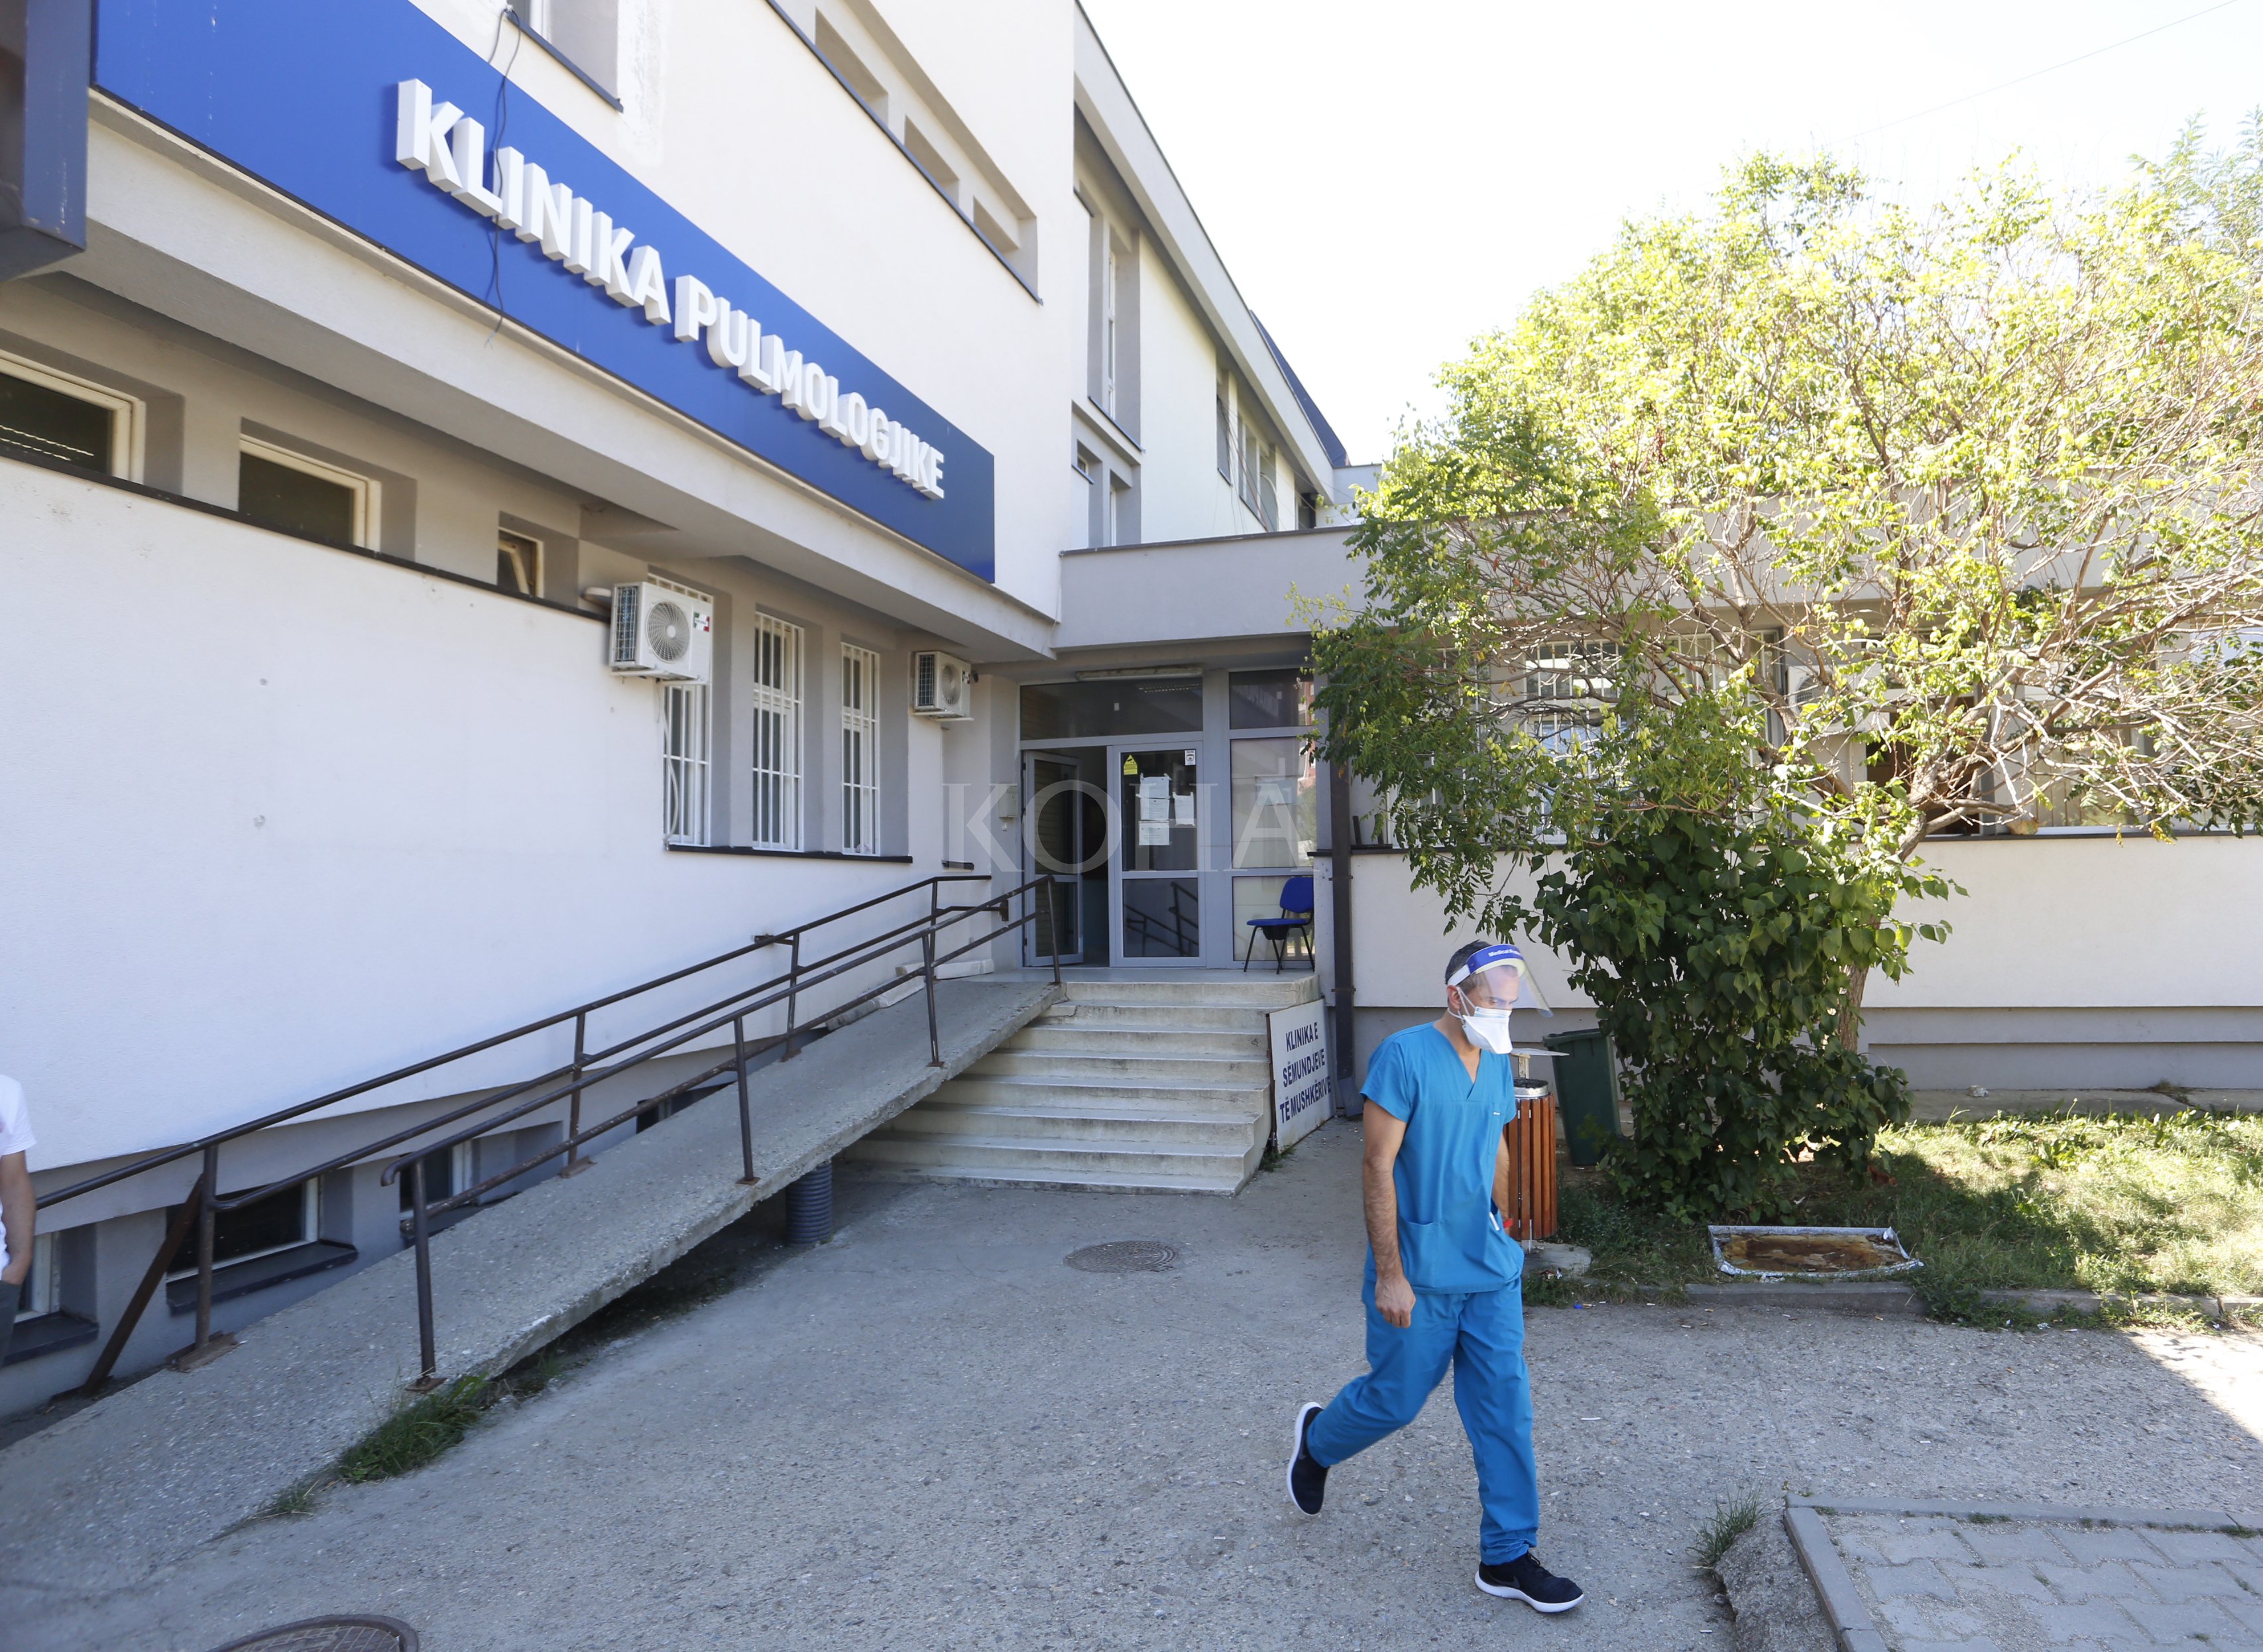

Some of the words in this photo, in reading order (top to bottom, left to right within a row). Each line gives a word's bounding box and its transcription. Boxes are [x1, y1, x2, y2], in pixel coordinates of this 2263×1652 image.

[396, 78, 671, 325] KLINIKA
[675, 274, 945, 500] PULMOLOGJIKE
[1286, 1025, 1314, 1051] KLINIKA
[1314, 1022, 1318, 1039] E
[1283, 1048, 1325, 1088] SËMUNDJEVE
[1279, 1096, 1290, 1124] TË
[1291, 1076, 1331, 1118] MUSHKËRIVE
